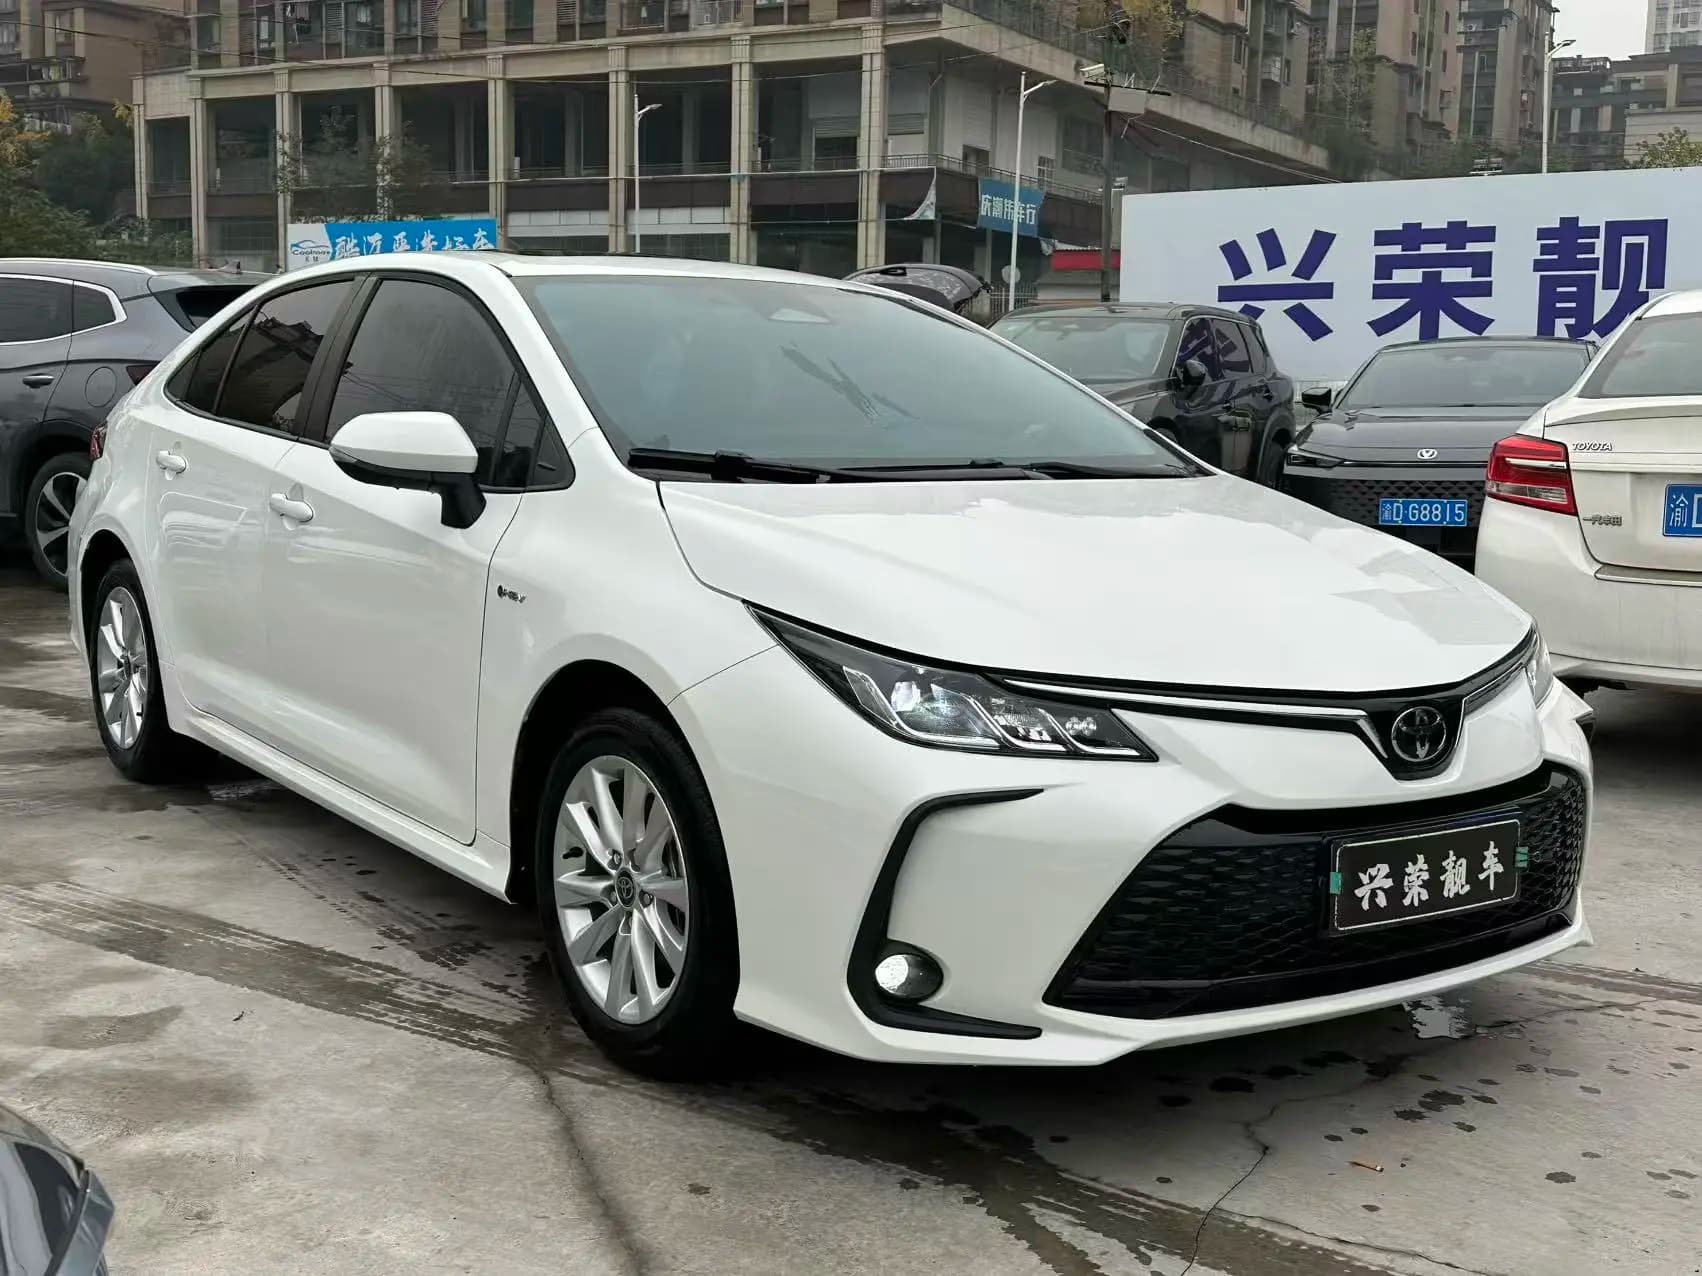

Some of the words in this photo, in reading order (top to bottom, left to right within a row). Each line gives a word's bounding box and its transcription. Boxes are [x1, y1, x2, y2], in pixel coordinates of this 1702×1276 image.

[1218, 216, 1668, 342] 兴荣靓
[1572, 442, 1613, 451] TOYOTA
[1582, 514, 1622, 526] 一汽丰田
[1354, 840, 1504, 912] 兴荣靓车
